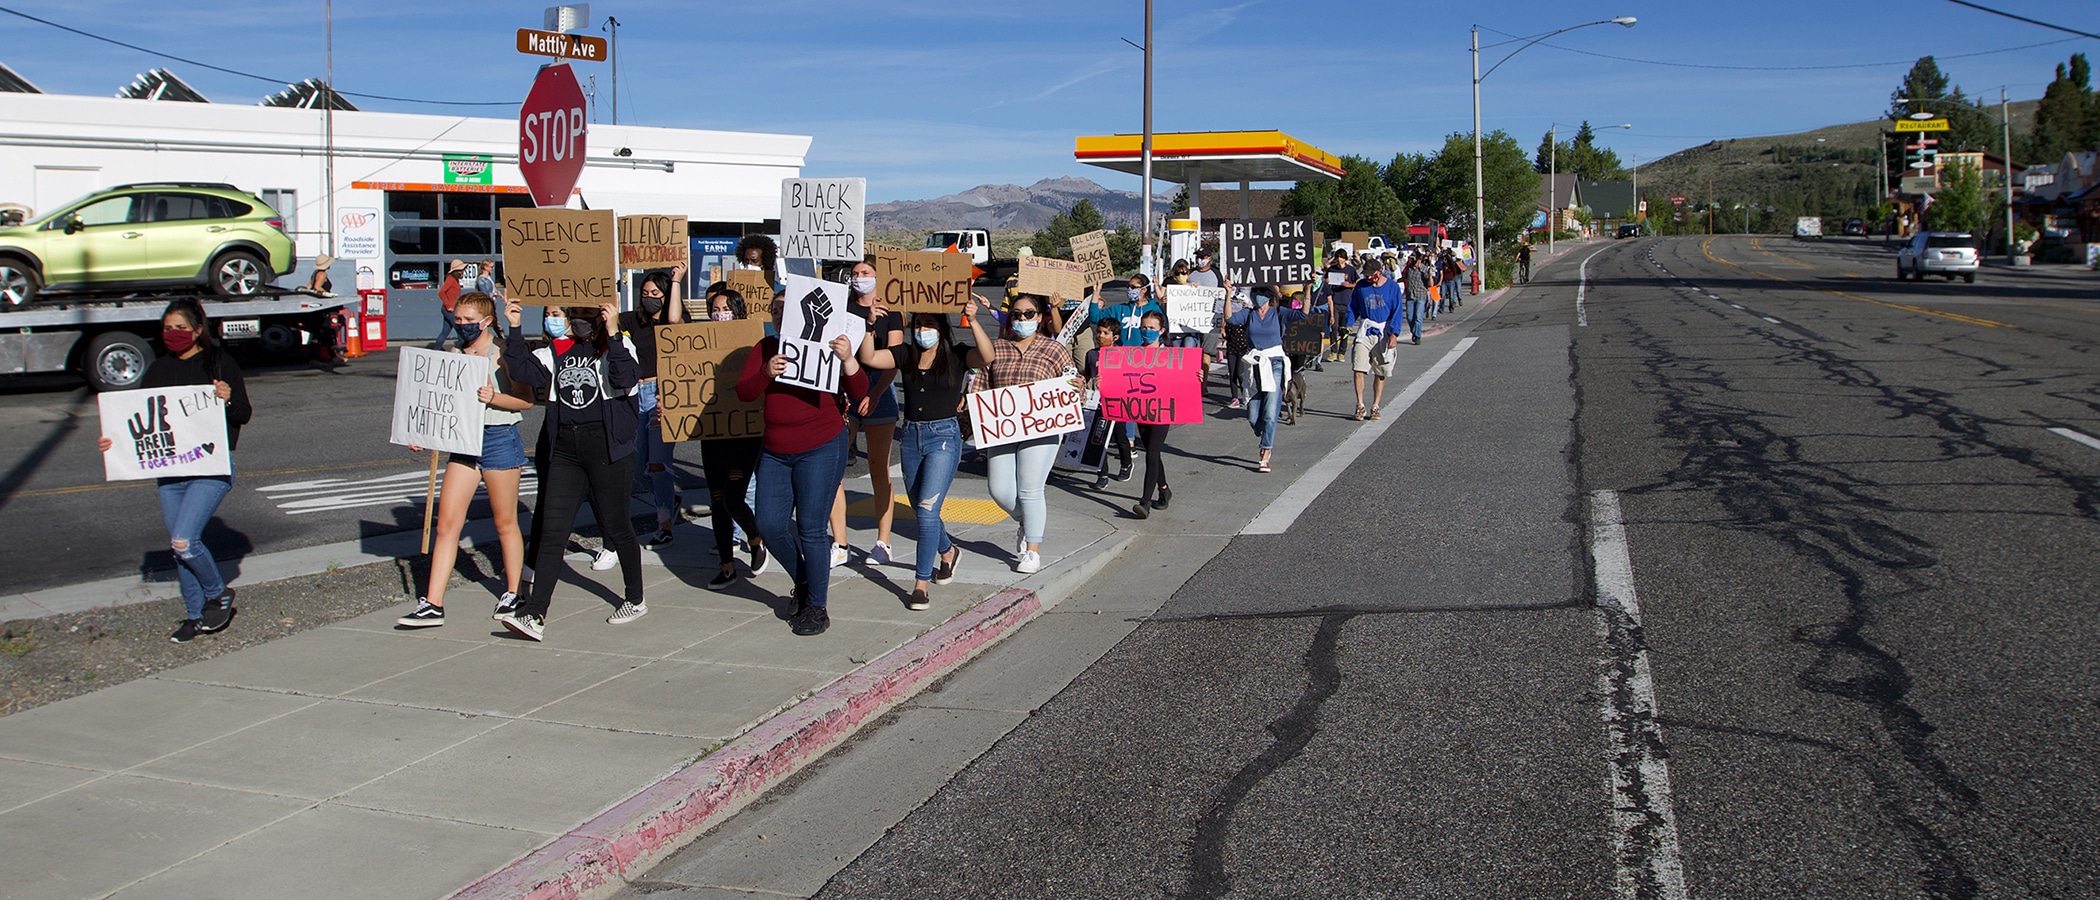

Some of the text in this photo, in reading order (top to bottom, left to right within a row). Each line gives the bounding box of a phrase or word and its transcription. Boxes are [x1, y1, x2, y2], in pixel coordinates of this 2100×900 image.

[528, 32, 595, 58] Mattly Ave
[523, 107, 584, 164] STOP
[1900, 121, 1946, 129] RESTAURANT
[367, 182, 495, 192] TIRES BATTERIES
[792, 183, 851, 210] BLACK
[343, 213, 365, 228] AAA
[617, 217, 685, 245] ILENCE
[797, 211, 845, 233] LIVES
[1233, 220, 1304, 240] BLACK
[507, 219, 601, 246] SILENCE
[1085, 231, 1103, 242] LIVES
[542, 249, 570, 263] IS
[785, 233, 857, 258] MATTER
[1077, 249, 1107, 263] BLACK
[1233, 243, 1307, 262] LIVES
[879, 256, 947, 275] Time for
[1025, 257, 1084, 271] SAY THEIR NAMES
[1230, 264, 1312, 284] MATTER
[507, 274, 612, 300] VIOLENCE
[746, 285, 770, 300] HATE
[885, 278, 971, 306] CHANGE!
[1169, 289, 1224, 299] ACKNOWLEDGE
[745, 302, 772, 314] OLENCE
[1180, 302, 1210, 312] WHITE
[1169, 317, 1223, 327] PRIVILEGE
[660, 327, 717, 354] Small
[1284, 340, 1319, 354] LENCE
[660, 356, 716, 377] Town
[779, 339, 836, 390] BLM
[1103, 347, 1184, 369] ENOUGH
[413, 355, 467, 392] BLACK
[1122, 372, 1156, 394] IS
[179, 390, 218, 417] BLM
[417, 389, 454, 413] LIVES
[572, 389, 584, 404] 30
[662, 378, 718, 410] BIG
[975, 382, 1080, 422] NO Justice
[127, 395, 171, 440] WE
[1104, 396, 1175, 422] ENOUGH
[407, 405, 458, 440] MATTER
[663, 409, 762, 440] VOICE
[980, 418, 1016, 444] NO
[1021, 405, 1082, 435] Peace!
[136, 448, 176, 460] THIS
[139, 446, 204, 469] TOGETHER
